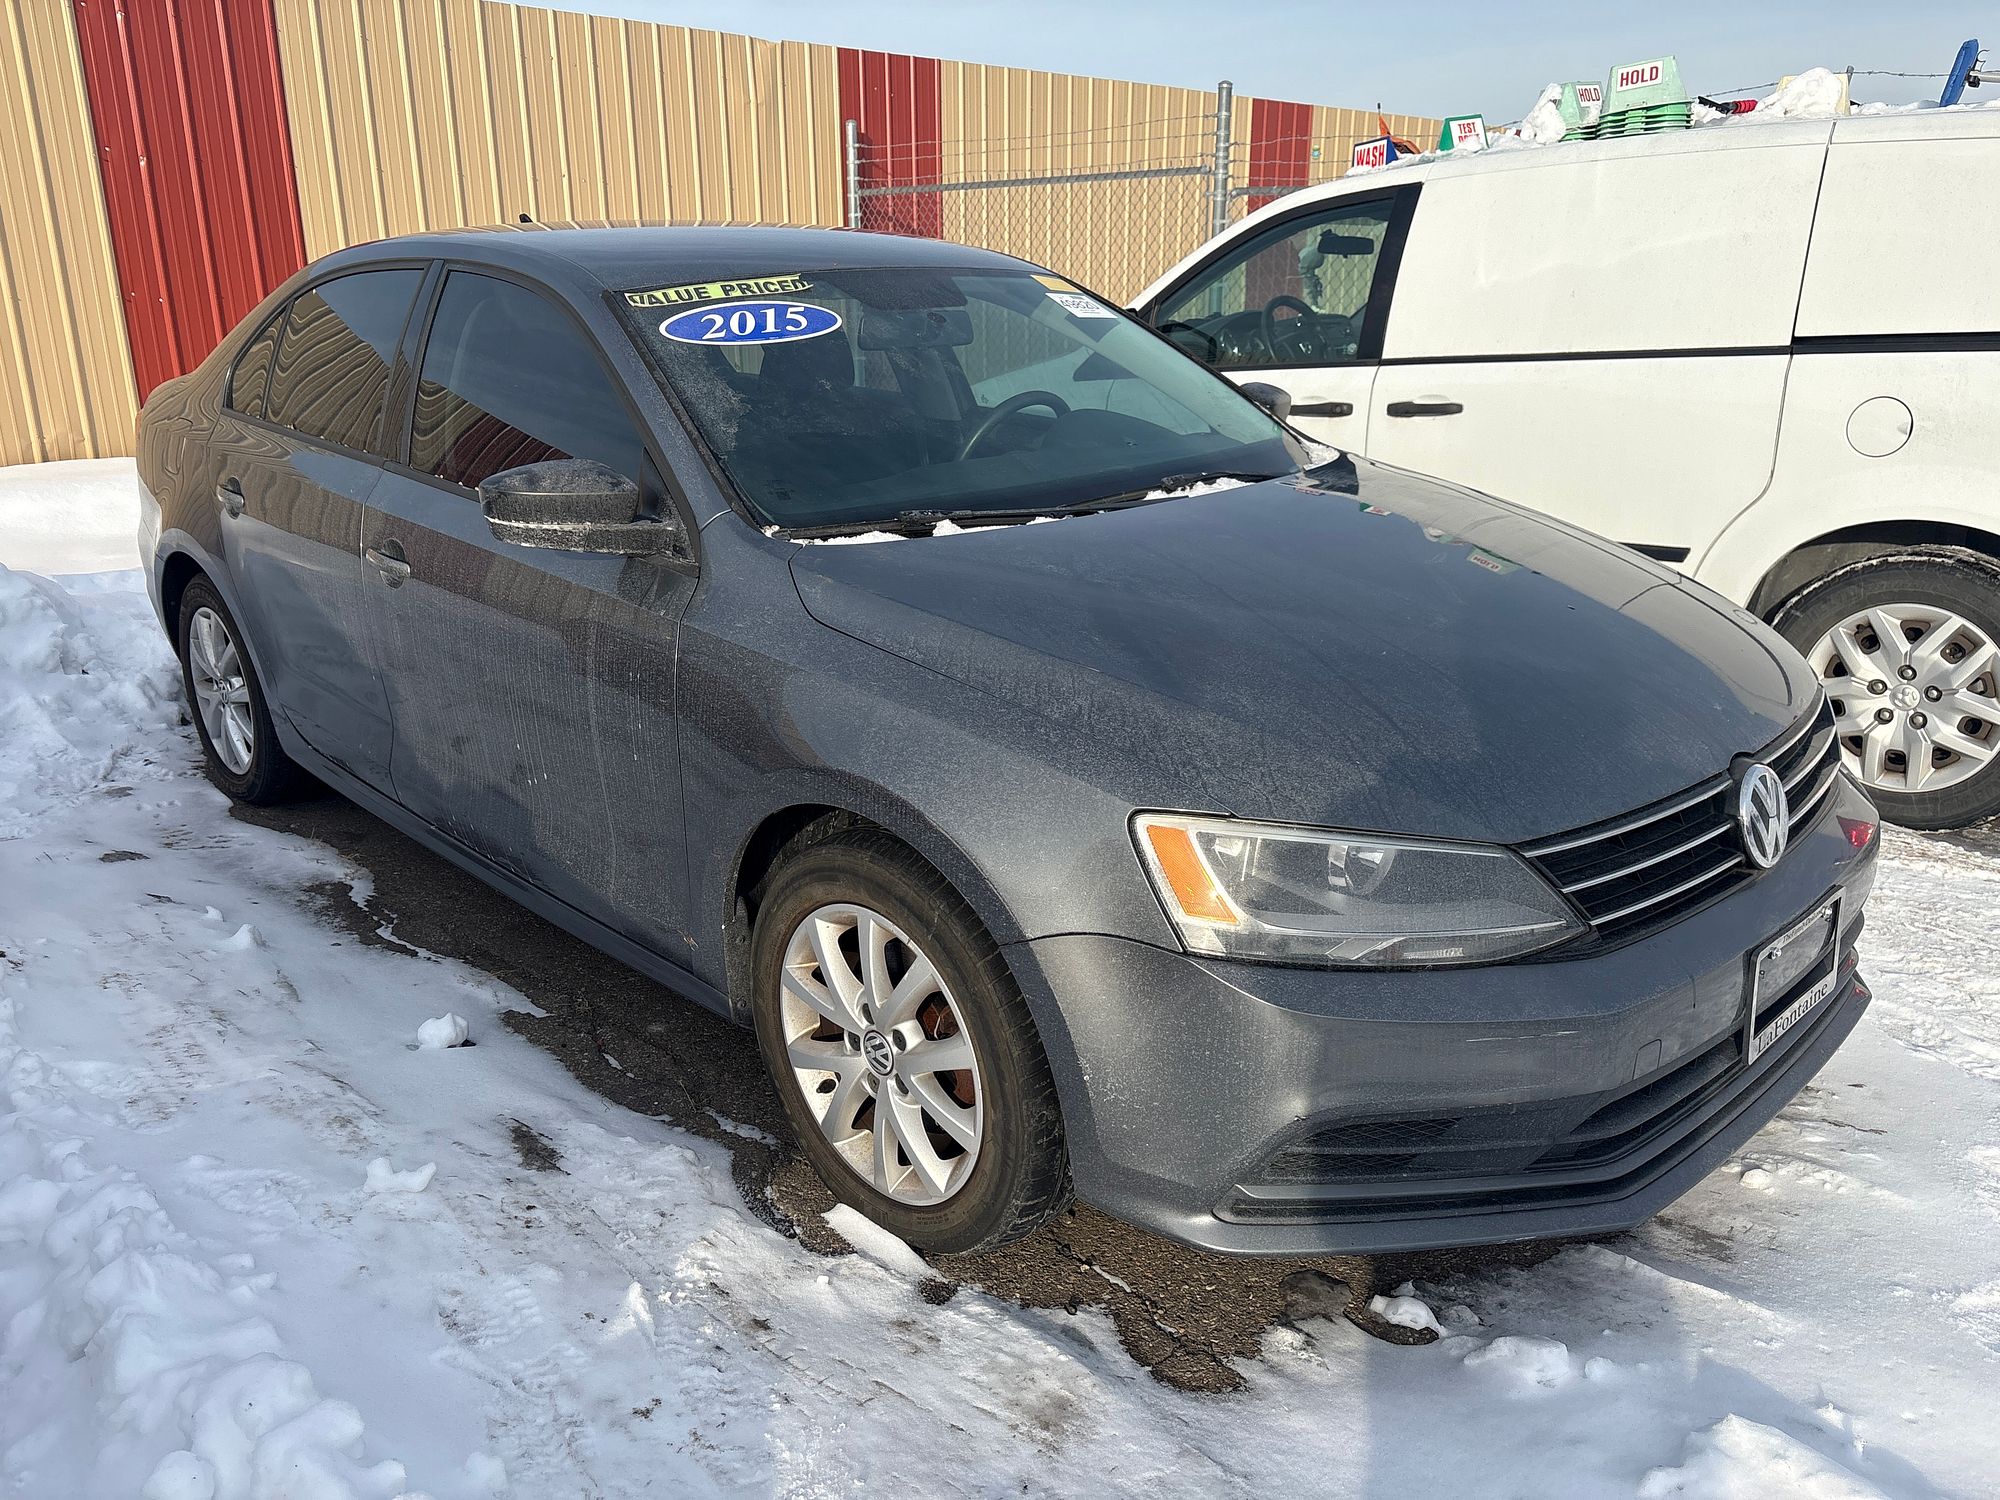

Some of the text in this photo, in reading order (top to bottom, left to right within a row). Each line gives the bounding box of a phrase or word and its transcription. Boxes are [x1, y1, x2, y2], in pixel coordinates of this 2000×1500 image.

[1619, 66, 1659, 87] HOLD
[1577, 87, 1601, 102] HOLD
[1457, 122, 1477, 134] TEST
[1356, 144, 1386, 167] WASH
[628, 286, 712, 305] VALUE
[700, 306, 808, 340] 2015
[1756, 983, 1829, 1055] LaFontaine
